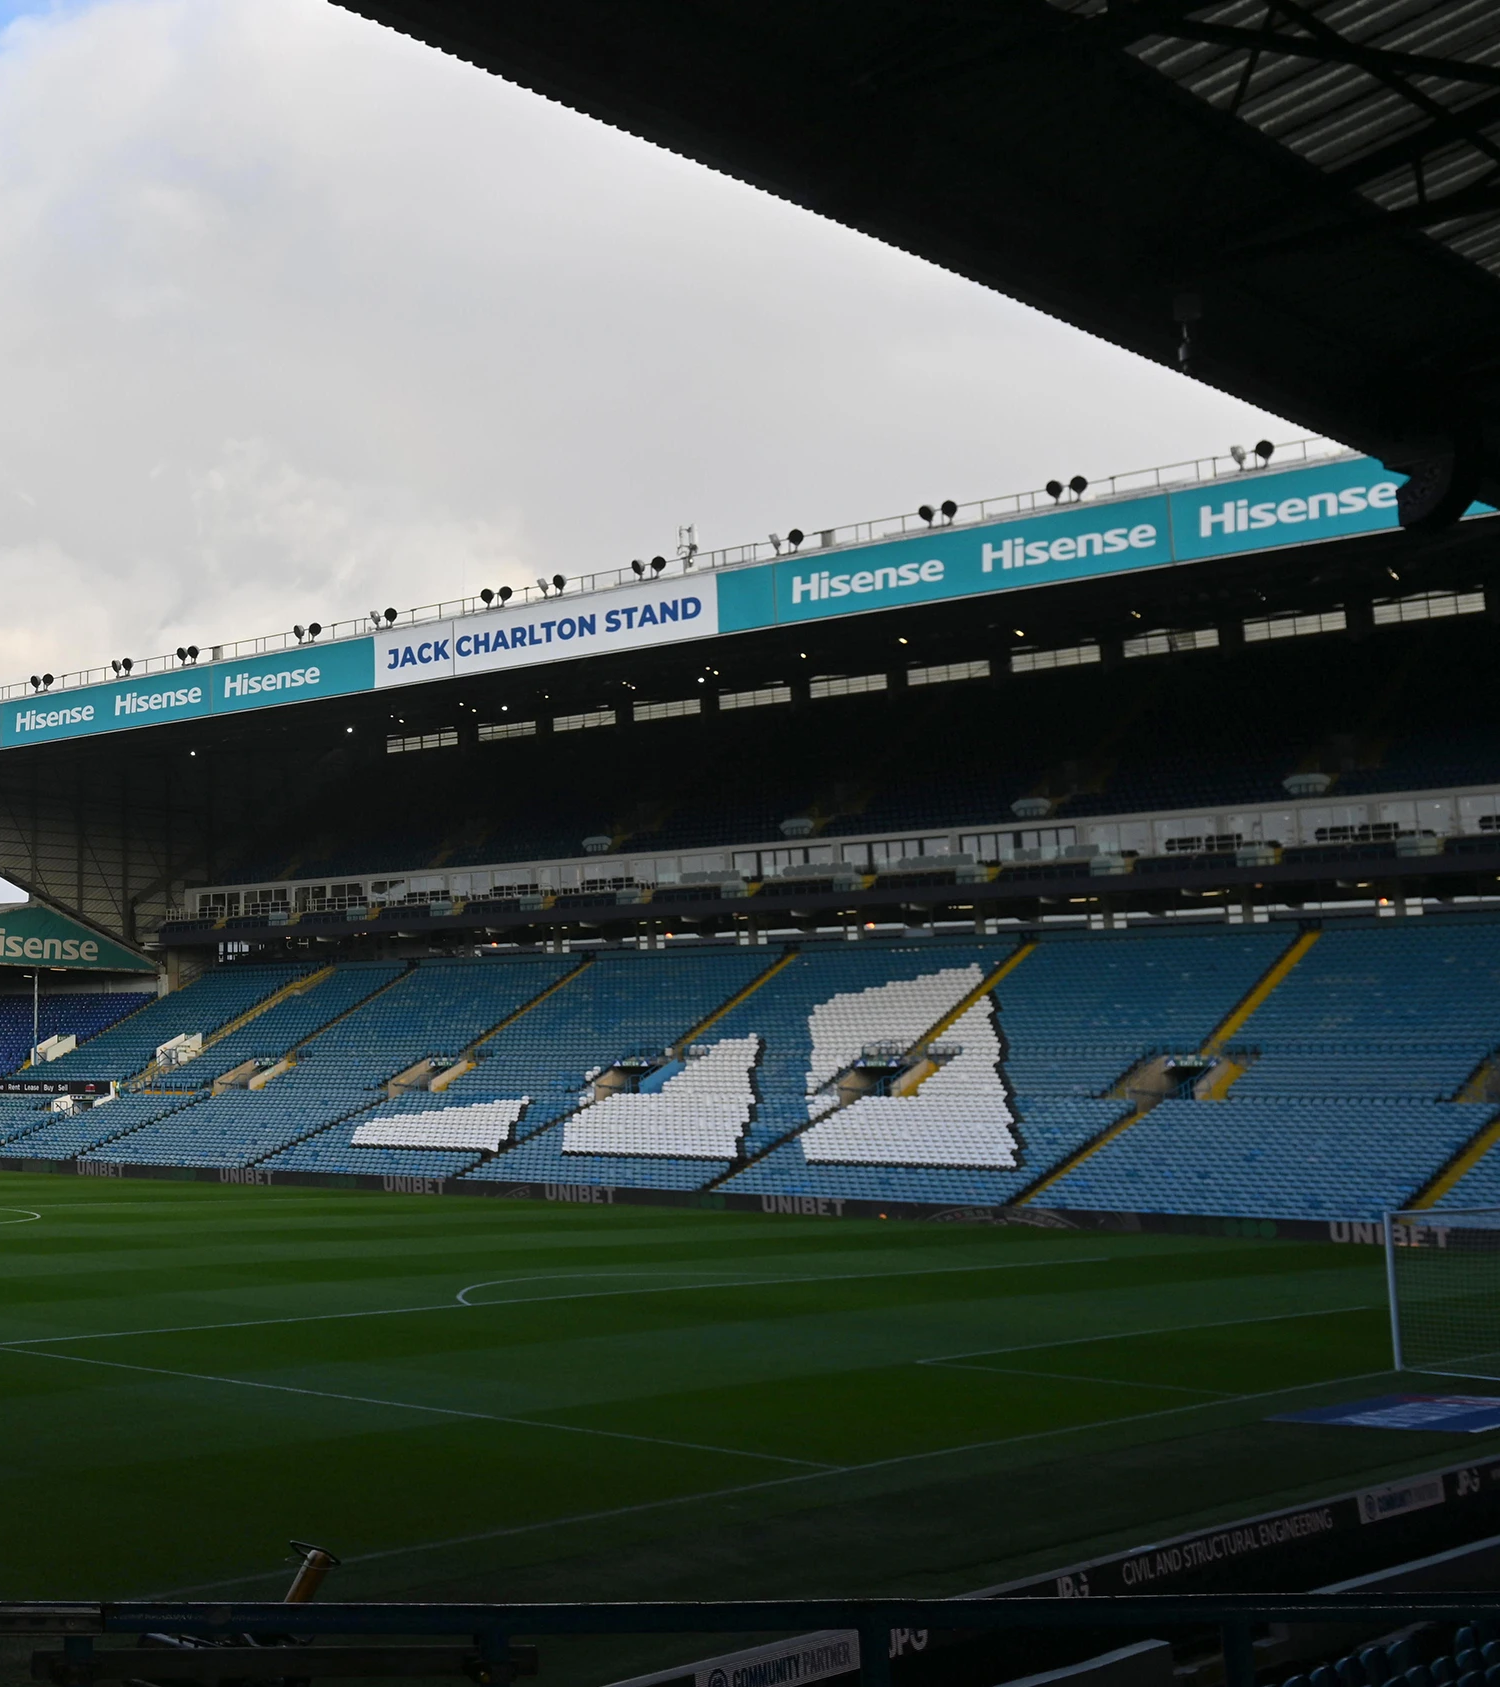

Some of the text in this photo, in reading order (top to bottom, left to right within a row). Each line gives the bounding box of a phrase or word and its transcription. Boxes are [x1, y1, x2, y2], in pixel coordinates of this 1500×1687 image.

[1200, 481, 1399, 537] Hisense
[982, 523, 1156, 573] Hisense
[792, 559, 945, 604] Hisense
[387, 596, 702, 670] JACK CHARLTON STAND
[224, 665, 321, 698] Hisense
[114, 686, 202, 717] Hisense
[15, 703, 95, 733] Hisense
[7, 1083, 20, 1091] Rent
[43, 1084, 54, 1092] Buy
[77, 1160, 124, 1177] UNIBET
[219, 1168, 274, 1185] UNIBET
[383, 1175, 446, 1195] UNIBET
[544, 1184, 616, 1205] UNIBET
[761, 1195, 845, 1217] UNIBET
[1328, 1220, 1450, 1248] UNIBET
[1121, 1561, 1155, 1586] CIVIL
[1156, 1549, 1182, 1576] AND
[1182, 1527, 1259, 1568] STRUCTURAL
[1259, 1508, 1334, 1547] ENGINEERING
[733, 1641, 851, 1687] COMMUNITY PARTNER
